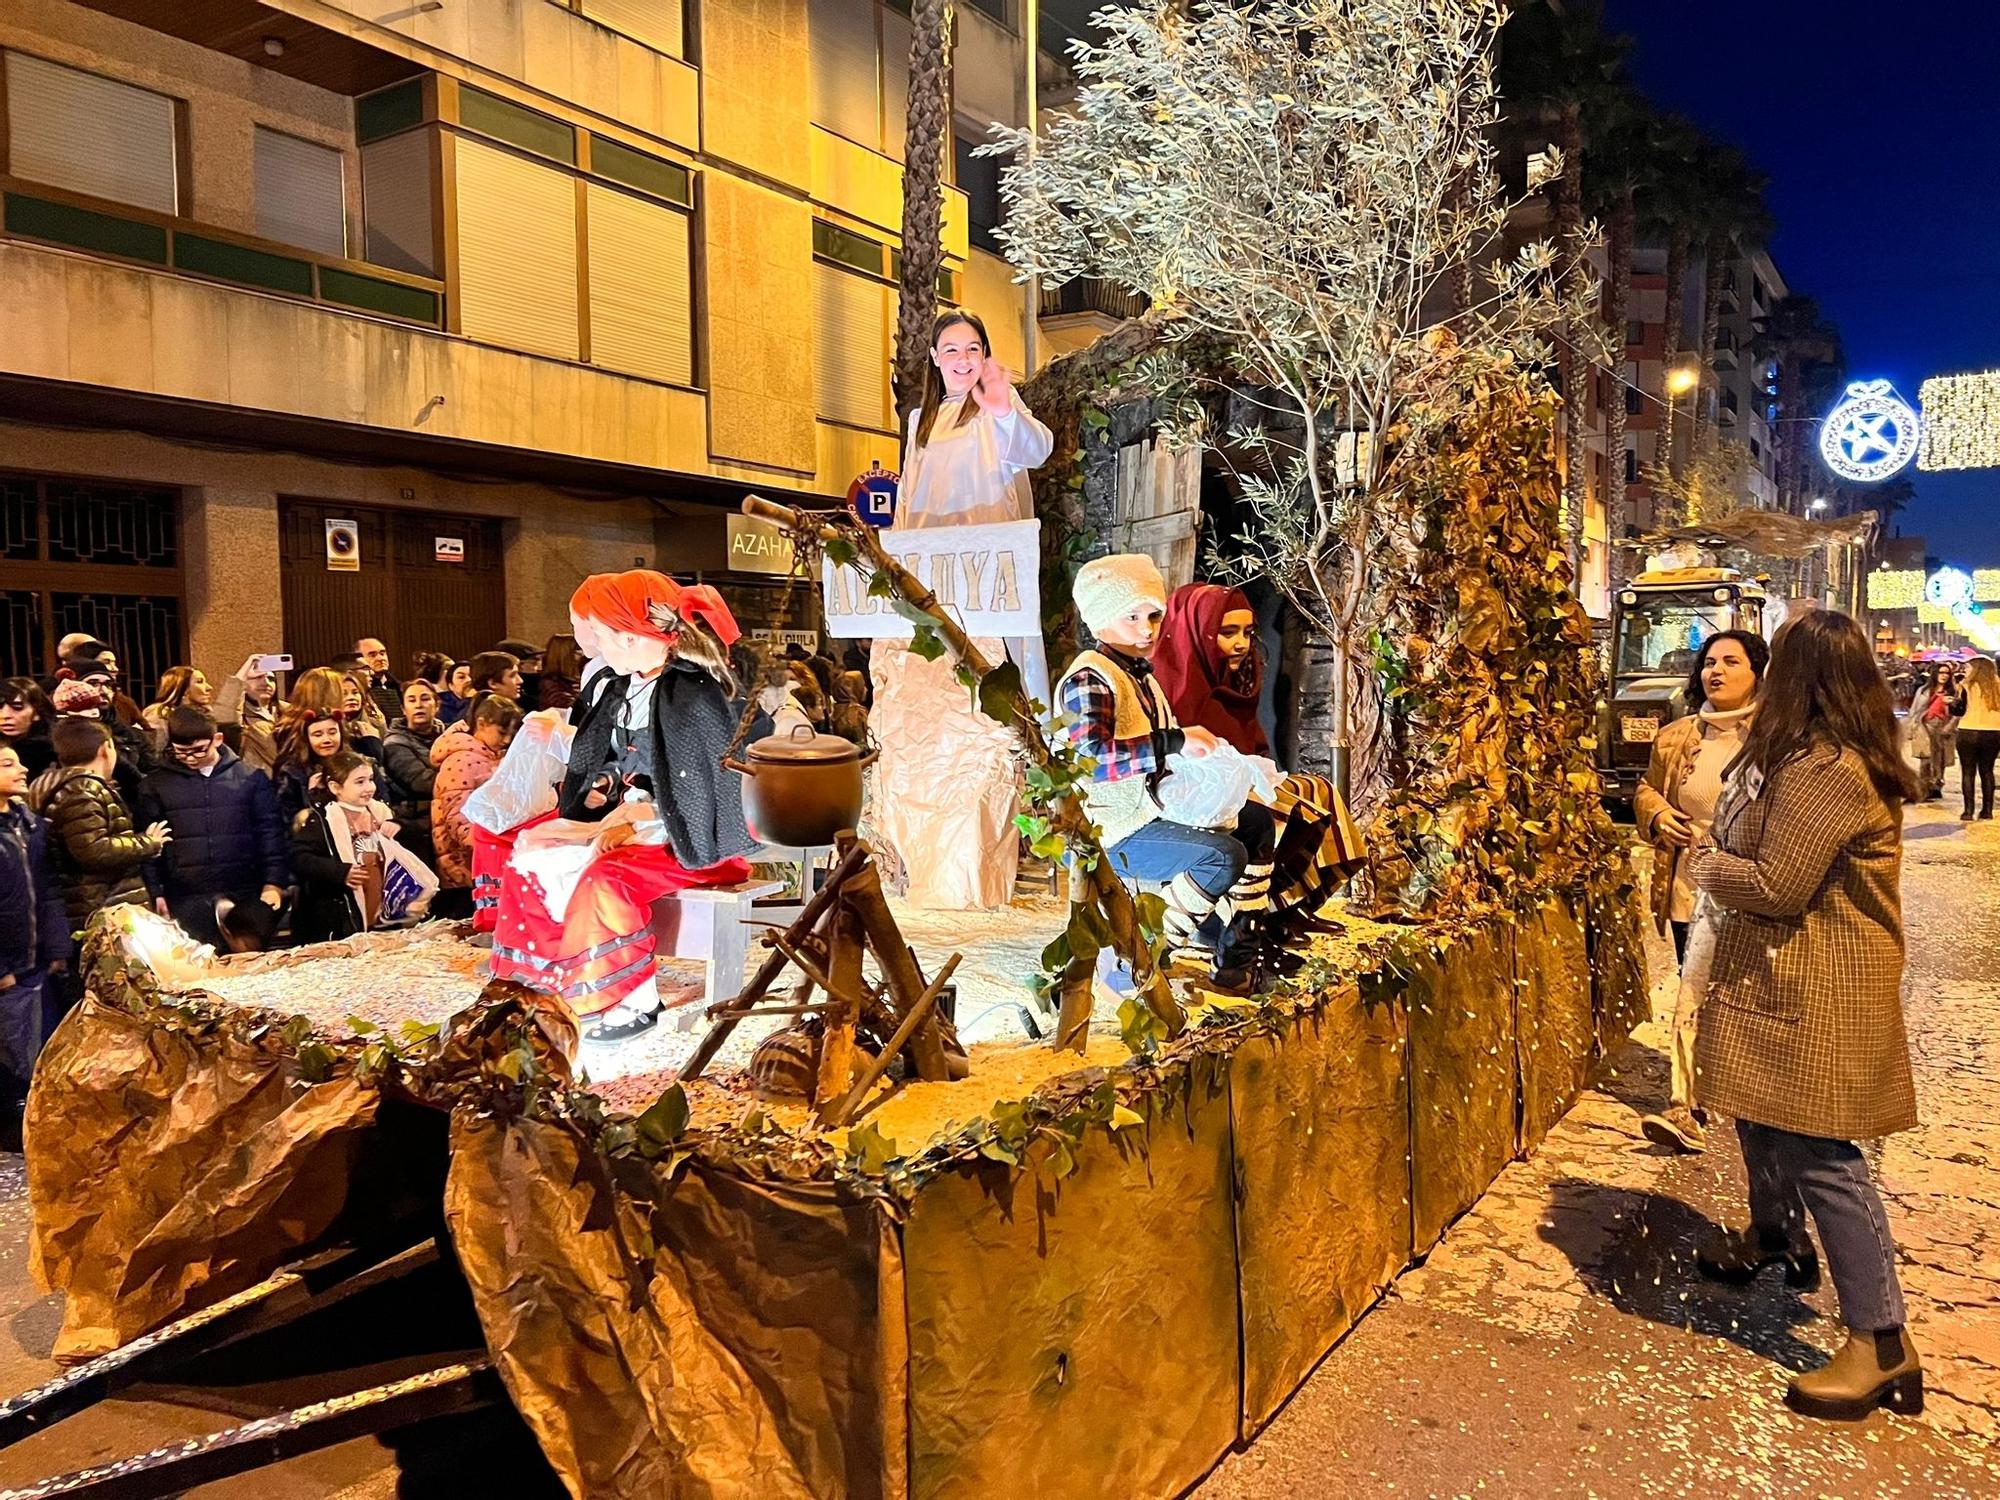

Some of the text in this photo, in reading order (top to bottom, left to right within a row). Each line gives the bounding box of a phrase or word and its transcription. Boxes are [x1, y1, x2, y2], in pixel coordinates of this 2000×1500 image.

[856, 469, 900, 484] EXCEPTO
[873, 494, 887, 511] P
[732, 532, 803, 558] AZAHA
[828, 550, 1021, 616] ALUYA
[773, 633, 816, 646] LQUILA
